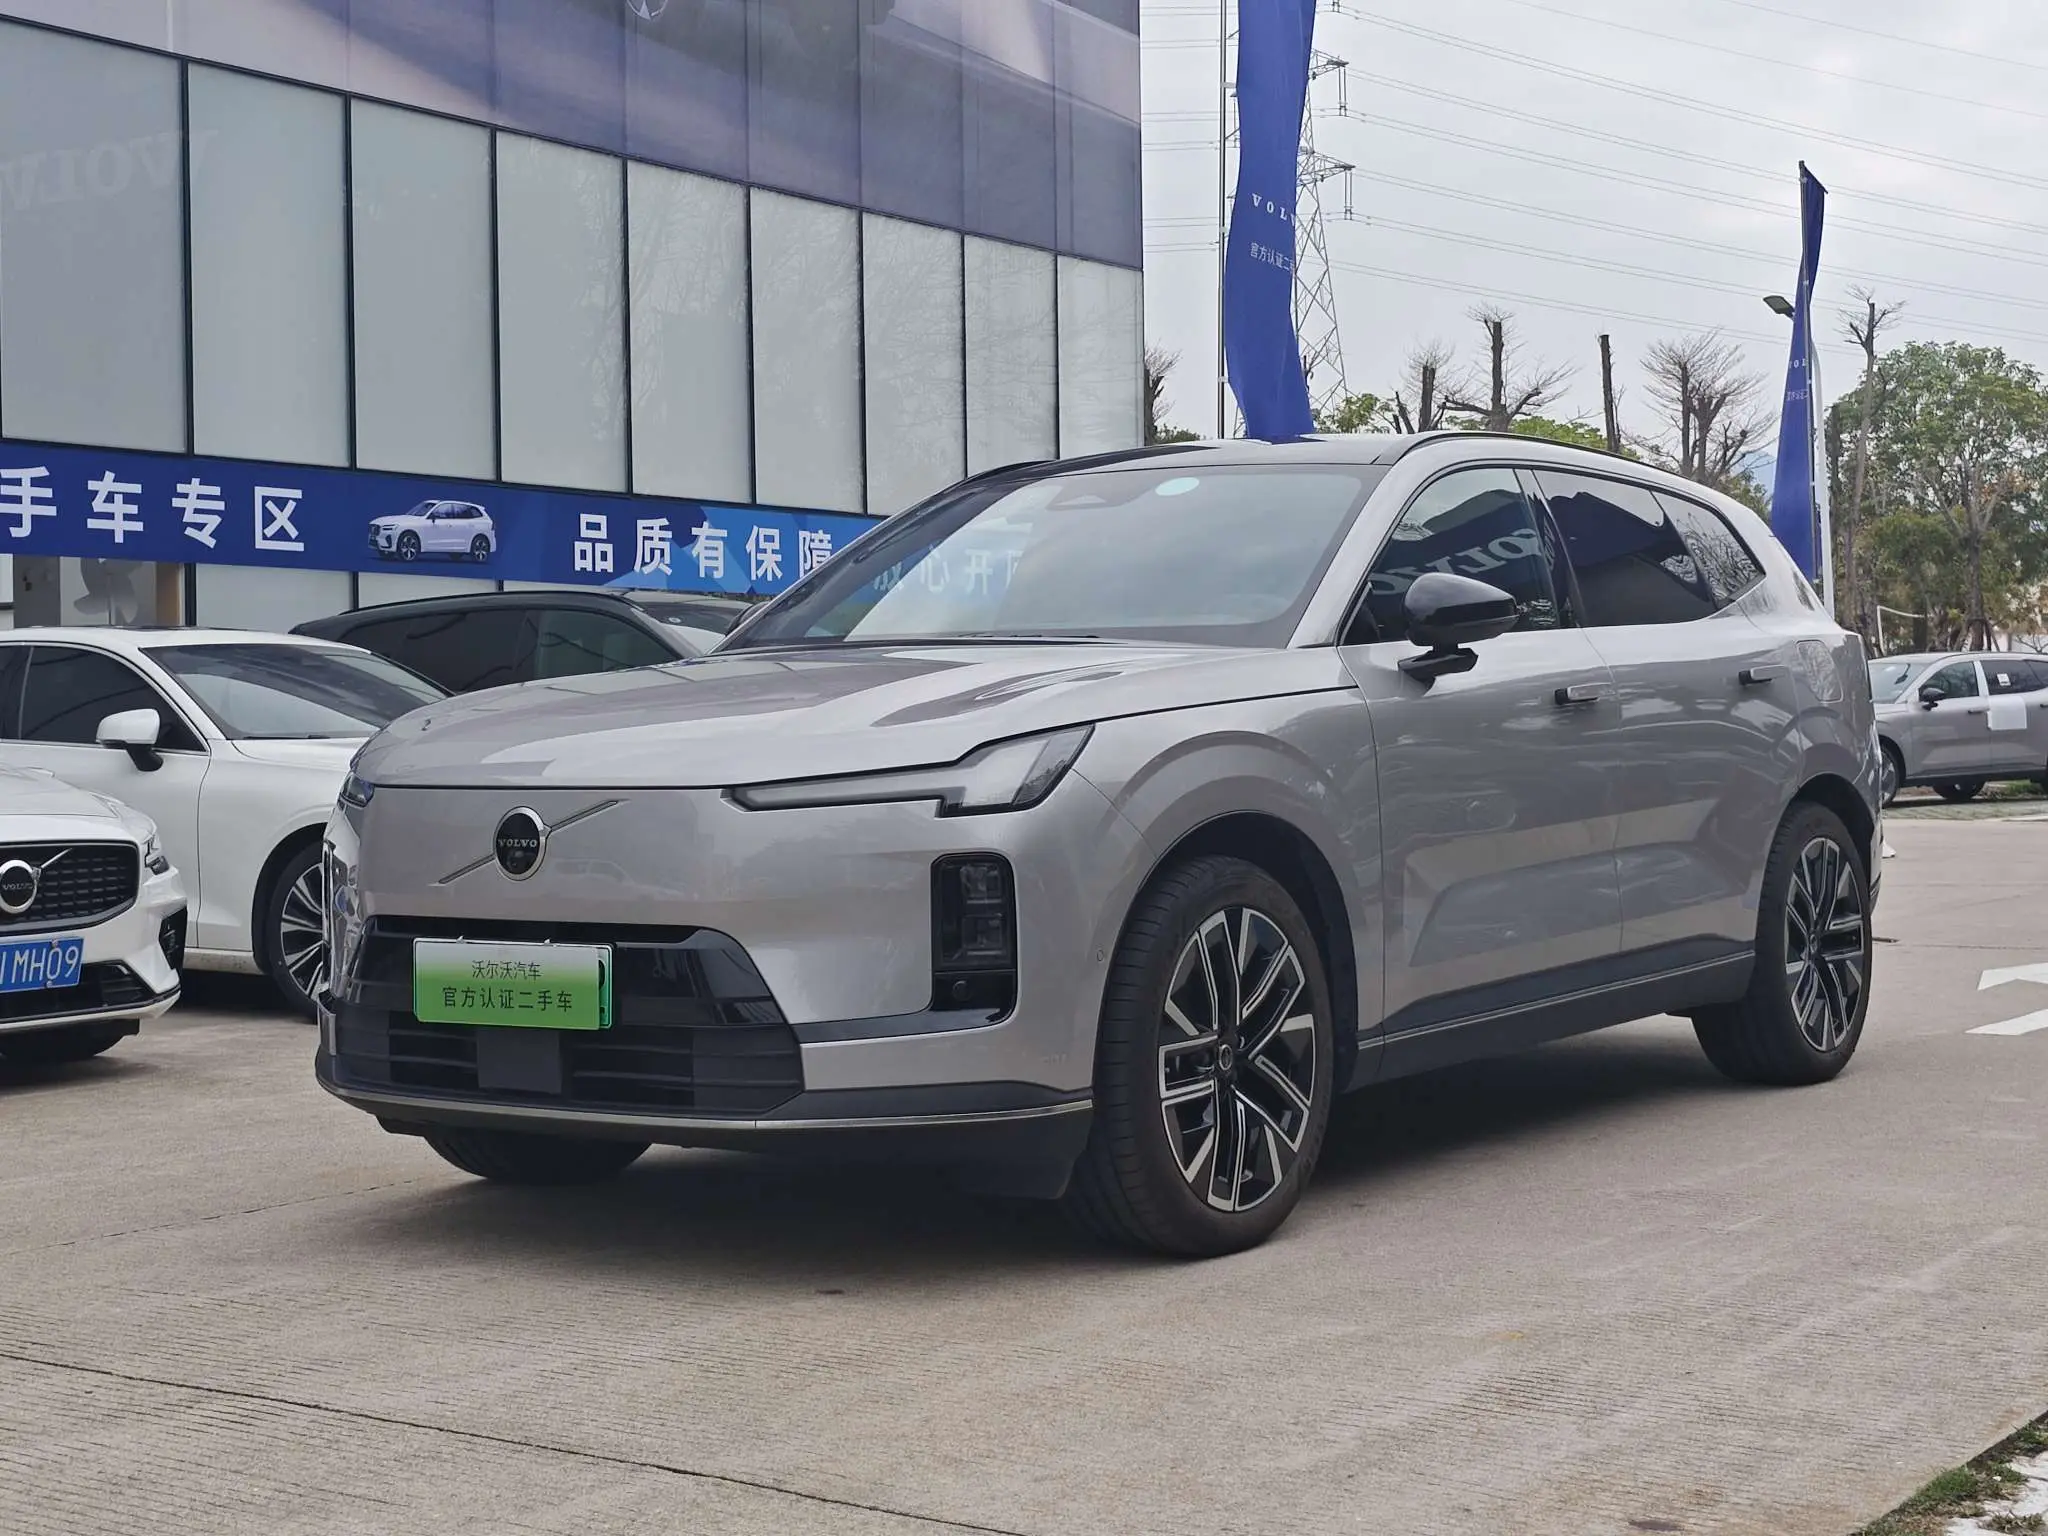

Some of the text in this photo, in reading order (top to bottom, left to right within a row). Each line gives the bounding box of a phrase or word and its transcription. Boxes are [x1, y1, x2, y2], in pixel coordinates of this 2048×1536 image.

[0, 466, 304, 551] 手车专区
[574, 513, 833, 582] 品质有保障
[498, 838, 538, 847] VOLVO
[471, 960, 543, 980] 沃尔沃汽车
[442, 987, 573, 1012] 官方认证二手车
